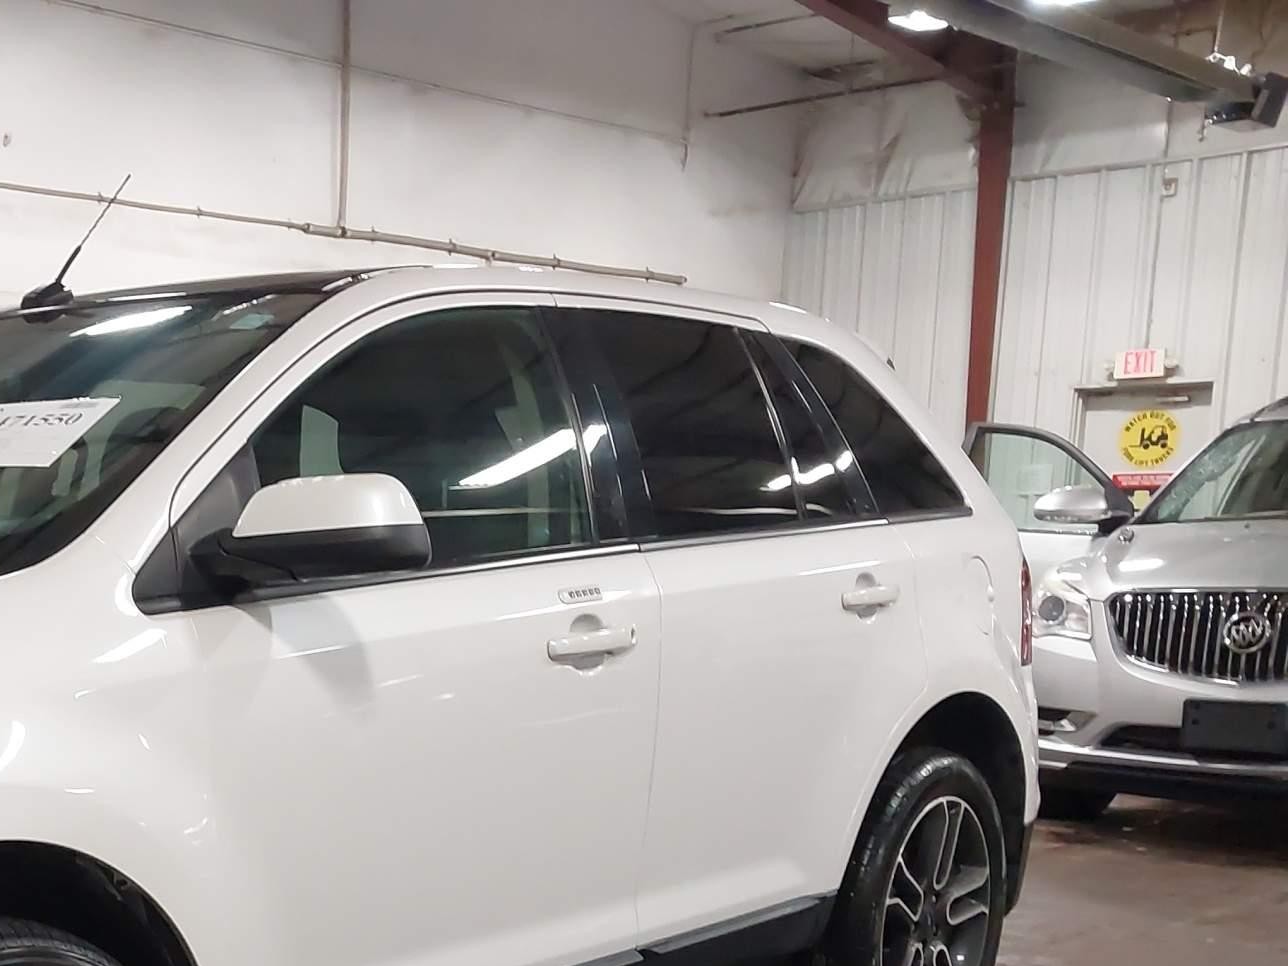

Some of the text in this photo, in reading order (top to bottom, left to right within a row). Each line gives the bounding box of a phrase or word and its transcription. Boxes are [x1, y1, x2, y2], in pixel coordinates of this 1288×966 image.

[1123, 350, 1157, 375] EXIT
[1125, 412, 1148, 432] WATCH
[1149, 410, 1165, 419] OUT
